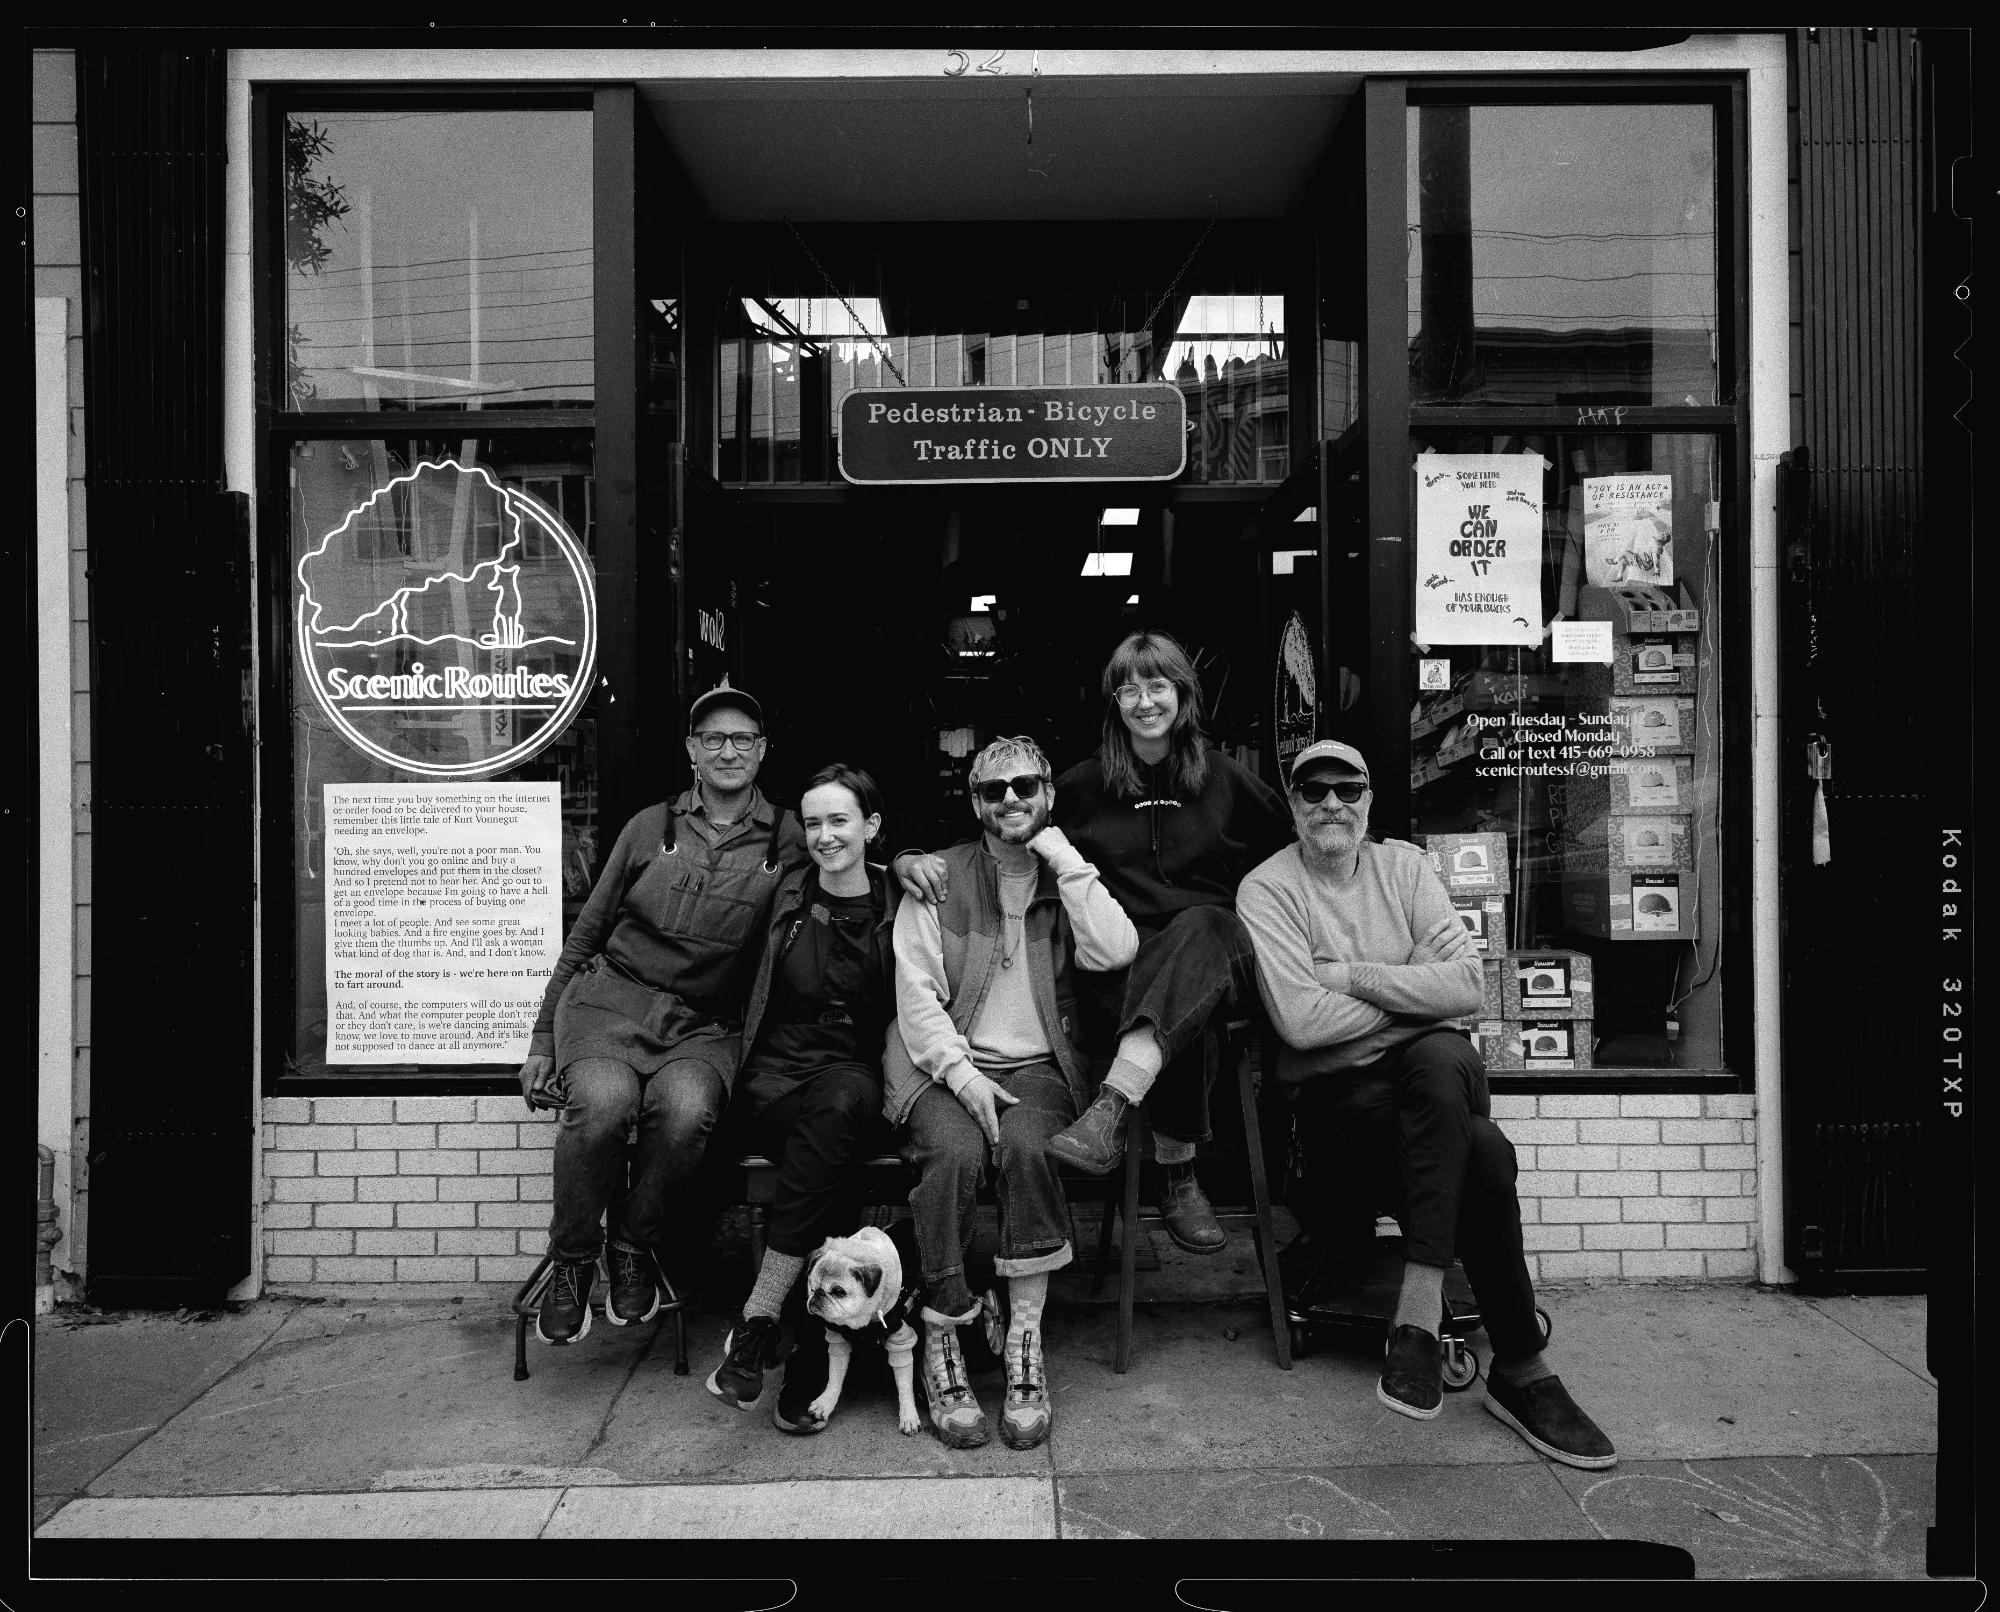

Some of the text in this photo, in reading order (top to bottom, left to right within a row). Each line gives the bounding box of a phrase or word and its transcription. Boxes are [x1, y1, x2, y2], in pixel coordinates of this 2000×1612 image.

[868, 402, 1022, 425] Pedestrian
[1044, 400, 1156, 426] Bicycle
[913, 437, 1112, 461] Traffic ONLY
[1456, 471, 1500, 480] SOMETHING
[1461, 481, 1476, 490] YOU
[1593, 485, 1611, 493] JOY
[1646, 483, 1662, 491] ACT
[1609, 491, 1664, 499] RESISTANCE
[1468, 504, 1490, 519] WE
[1460, 520, 1498, 538] CAN
[1449, 539, 1506, 557] ORDER
[1471, 559, 1491, 577] IT
[1454, 593, 1509, 602] HAS ENOUGH
[1446, 604, 1457, 612] OF
[1458, 604, 1482, 613] YOUR
[327, 662, 572, 700] Scenic Routes
[1493, 689, 1527, 705] KALI
[1467, 713, 1506, 730] Open
[1510, 713, 1565, 729] Tuesday
[1579, 712, 1630, 728] Sunday
[1515, 728, 1562, 743] Closed
[1565, 728, 1620, 744] Monday
[1480, 745, 1656, 760] Call or text 415-669-0958
[333, 796, 349, 804] The
[375, 795, 394, 804] time
[397, 798, 413, 806] you
[416, 795, 432, 806] buy
[436, 795, 481, 806] something
[499, 795, 512, 803] the
[516, 795, 550, 803] internet
[345, 806, 369, 814] order
[372, 806, 391, 814] food
[395, 806, 403, 814] to
[407, 805, 416, 814] be
[420, 805, 460, 814] delivered
[475, 807, 495, 816] your
[334, 815, 517, 826] remember this little tale of Kurt Vonnegut
[334, 826, 368, 837] needing
[356, 847, 370, 855] she
[451, 847, 465, 855] not
[476, 848, 497, 857] poor
[525, 846, 540, 854] You
[362, 857, 380, 867] why
[409, 859, 424, 867] you
[428, 859, 438, 867] go
[441, 856, 468, 865] online
[472, 856, 488, 864] and
[491, 856, 508, 867] buy
[334, 866, 541, 878] hundred envelopes and put them in the closet?
[334, 877, 351, 886] And
[374, 877, 408, 888] pretend
[440, 877, 459, 885] hear
[482, 876, 499, 885] And
[502, 879, 513, 887] go
[516, 877, 530, 885] out
[534, 877, 542, 885] to
[334, 970, 352, 978] The
[355, 970, 382, 978] moral
[386, 970, 396, 978] of
[399, 970, 413, 978] the
[417, 970, 440, 980] story
[443, 969, 450, 978] is
[487, 969, 508, 978] here
[527, 969, 552, 977] Earth
[335, 981, 344, 989] to
[347, 980, 364, 989] fart
[353, 1042, 394, 1052] supposed
[397, 1042, 406, 1050] to
[409, 1041, 435, 1050] dance
[438, 1042, 447, 1050] at
[449, 1041, 460, 1050] all
